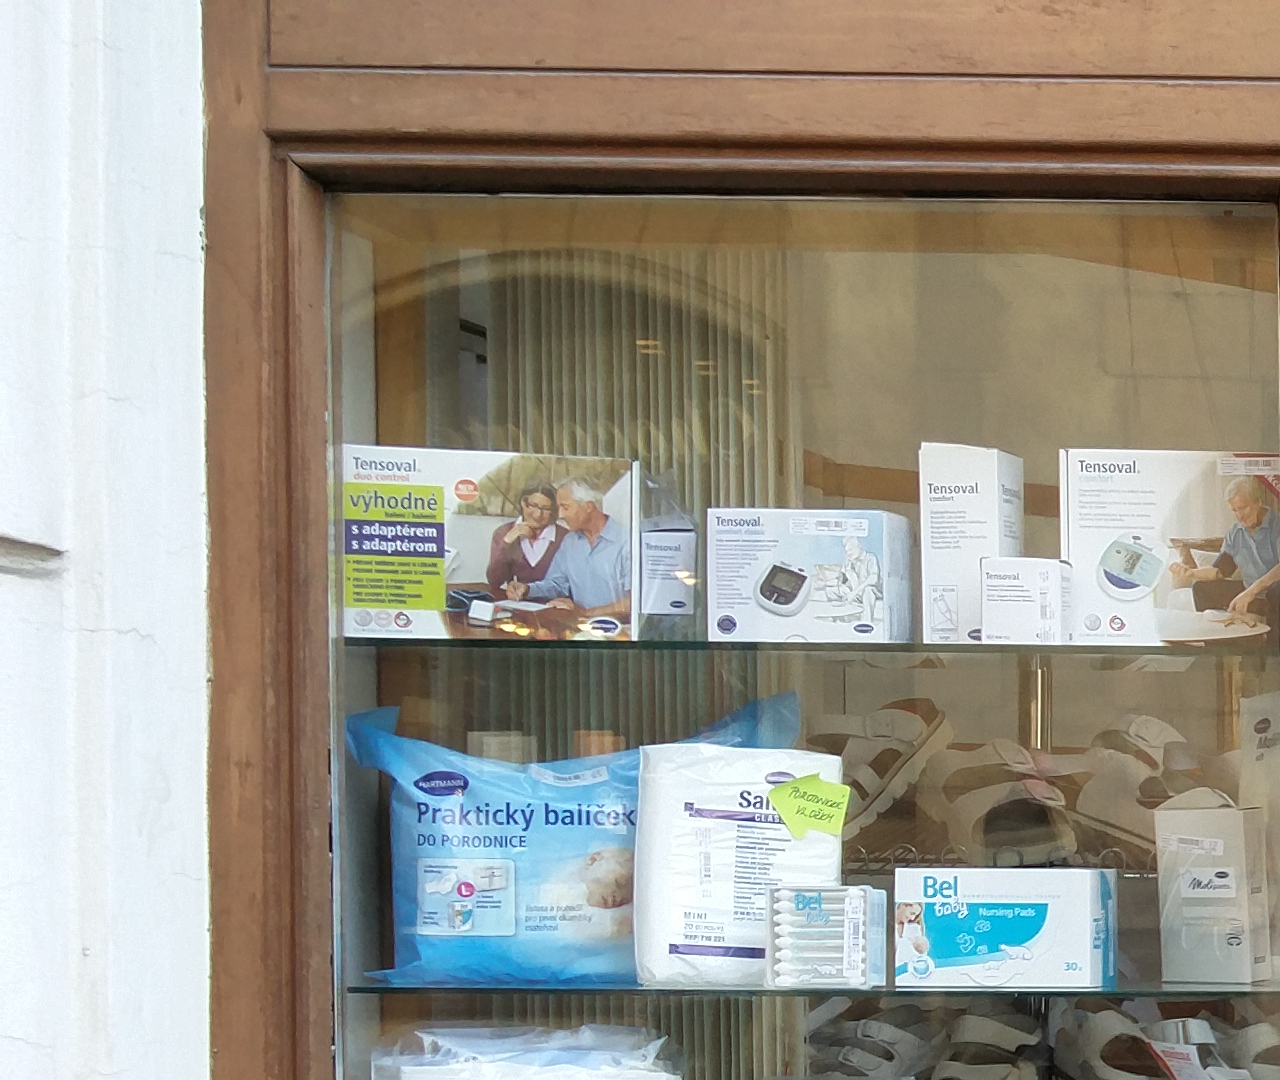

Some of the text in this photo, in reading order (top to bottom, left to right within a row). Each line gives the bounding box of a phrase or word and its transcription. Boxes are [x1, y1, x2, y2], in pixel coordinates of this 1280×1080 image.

[353, 456, 417, 473] Tensoval
[1078, 459, 1137, 474] Tensoval
[375, 474, 410, 483] control
[927, 482, 978, 495] Tensoval
[349, 489, 439, 514] výhodné
[715, 516, 761, 528] Tensoval
[351, 522, 438, 541] s adaptérem
[351, 538, 438, 554] s adaptérom
[986, 572, 1019, 581] Tensoval
[417, 802, 636, 832] Praktický balíček
[417, 834, 527, 849] DO PORODNICE
[461, 885, 471, 896] L
[922, 875, 959, 899] Bel
[794, 891, 822, 911] Bel
[933, 900, 969, 919] baby
[979, 907, 1036, 919] Nursing Pads
[1064, 961, 1078, 972] 30
